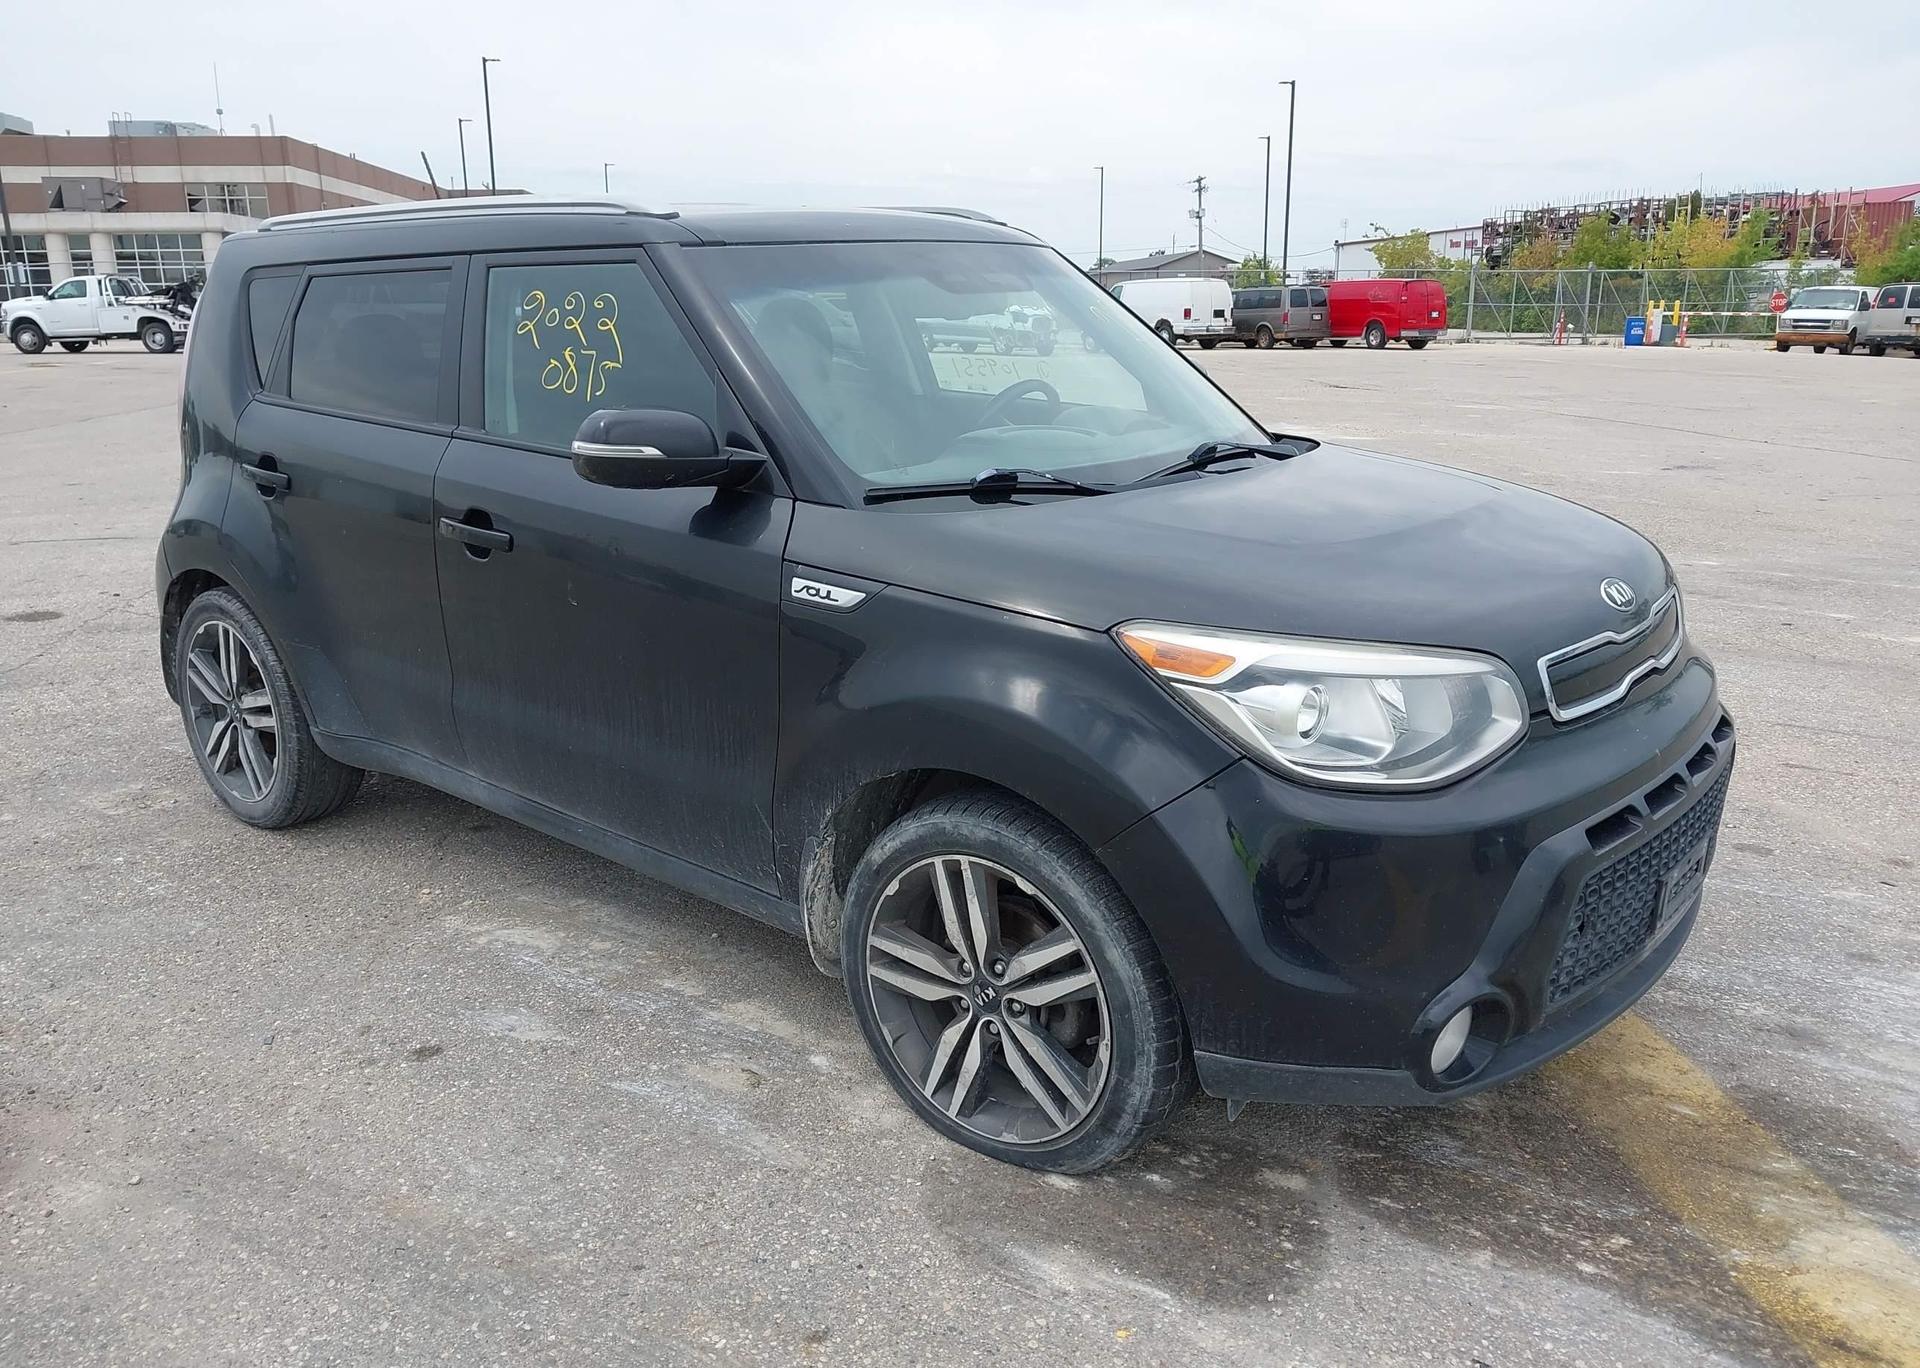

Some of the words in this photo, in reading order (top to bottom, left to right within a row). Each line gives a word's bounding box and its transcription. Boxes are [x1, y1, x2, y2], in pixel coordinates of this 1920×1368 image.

[1770, 298, 1787, 307] STOP
[516, 290, 623, 364] 2022
[541, 346, 622, 402] 0875
[1604, 580, 1634, 606] KIA
[974, 986, 997, 1007] KIA
